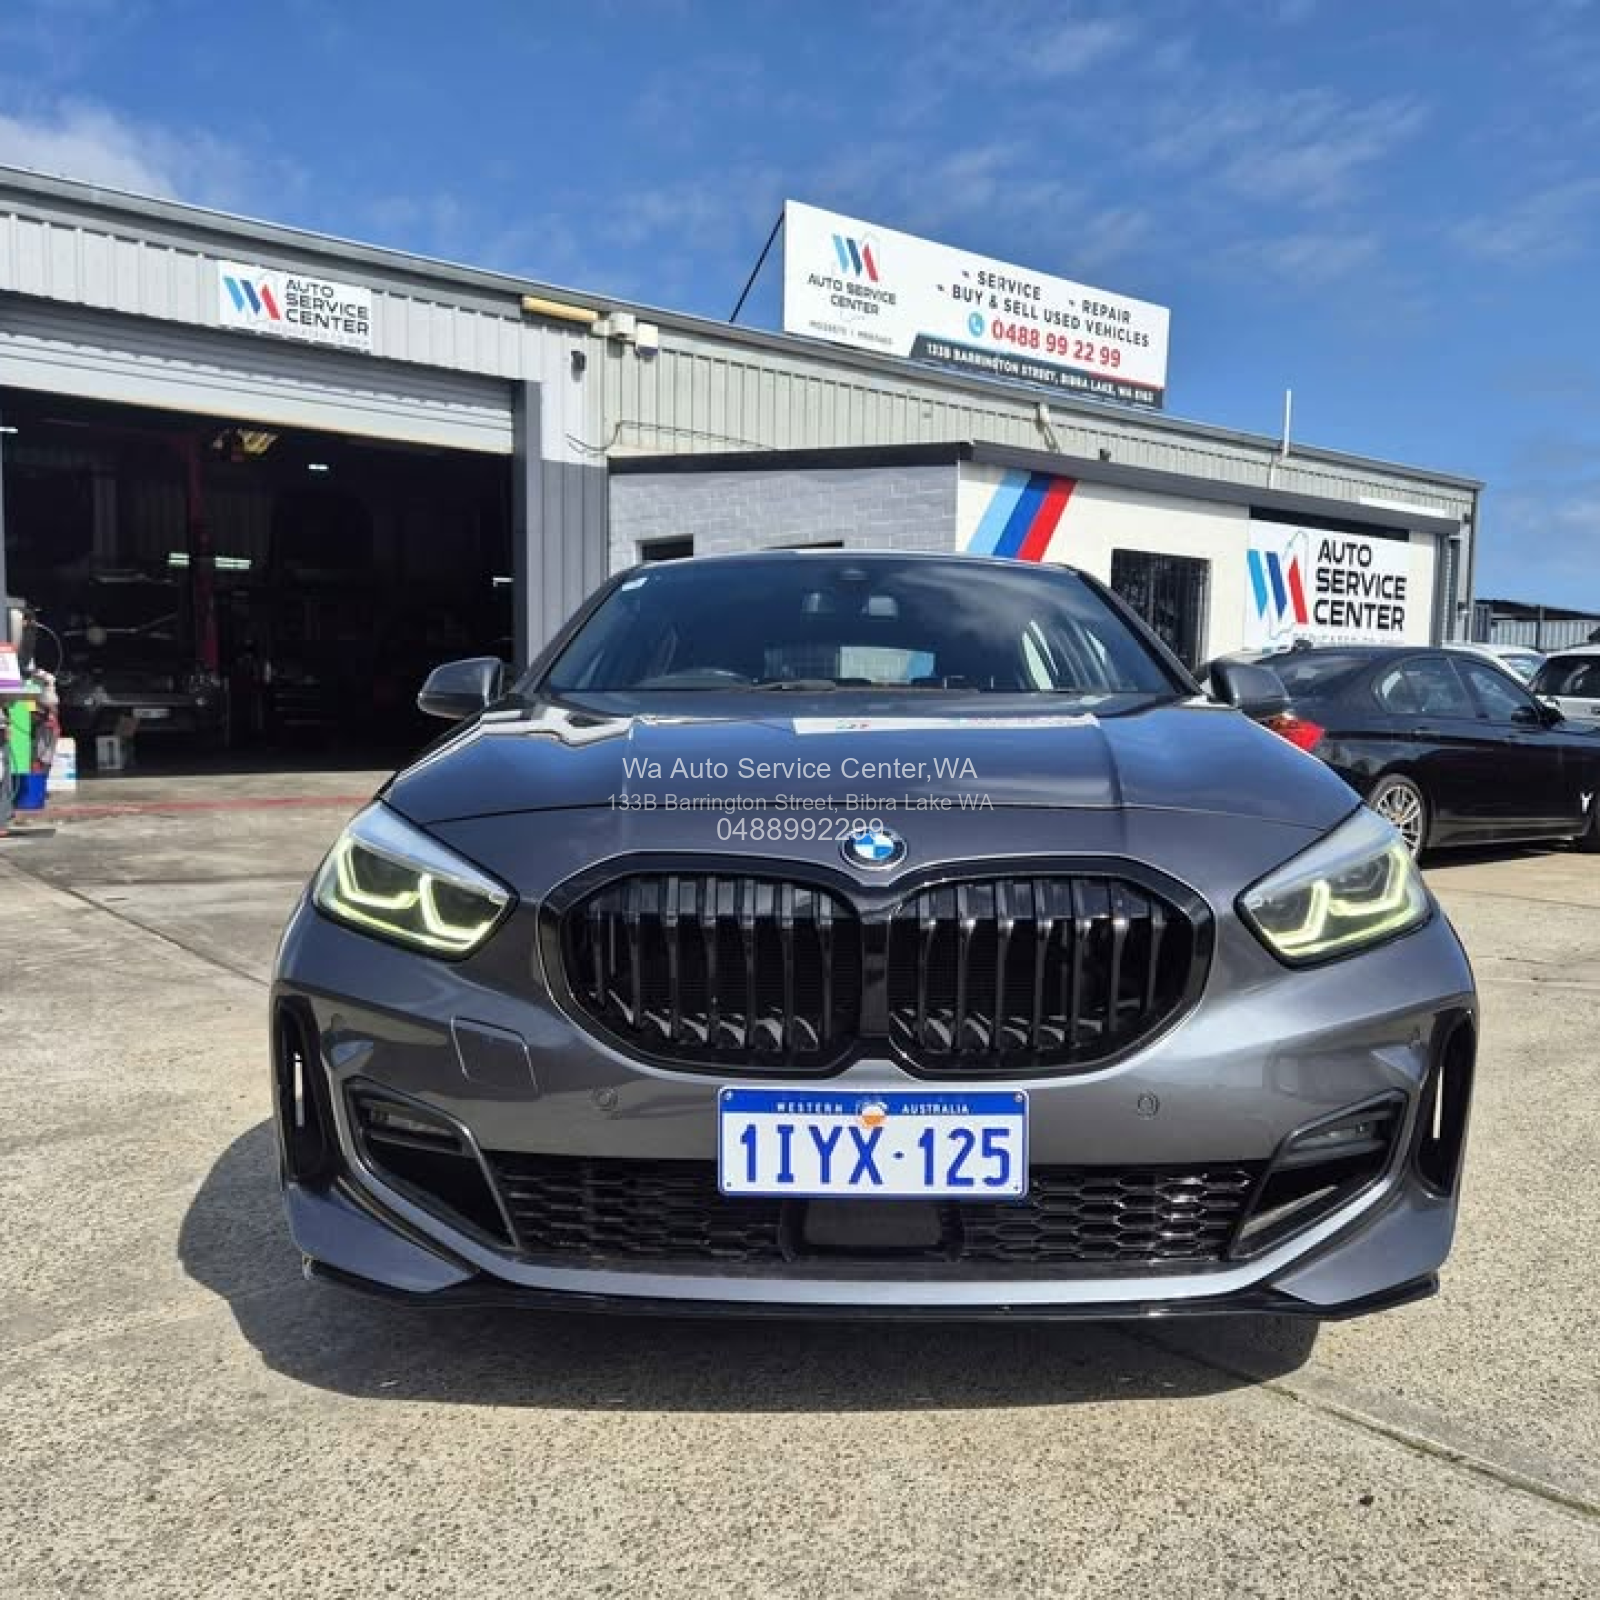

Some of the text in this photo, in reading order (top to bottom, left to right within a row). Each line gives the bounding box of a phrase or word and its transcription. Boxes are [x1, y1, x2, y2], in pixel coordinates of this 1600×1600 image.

[286, 279, 334, 298] AUTO
[808, 272, 897, 305] AUTO SERVICE
[978, 270, 1131, 325] SERVICE REPAIR
[286, 292, 369, 321] SERVICE
[830, 294, 879, 315] CENTER
[952, 284, 1150, 348] BUY & SELL USED VEHICLES
[286, 308, 369, 335] CENTER
[991, 318, 1121, 369] 0488 99 22 99
[1317, 538, 1372, 567] AUTO
[1315, 567, 1407, 600] SERVICE
[1313, 598, 1405, 632] CENTER
[777, 1101, 971, 1115] WESTERN AUSTRALIA
